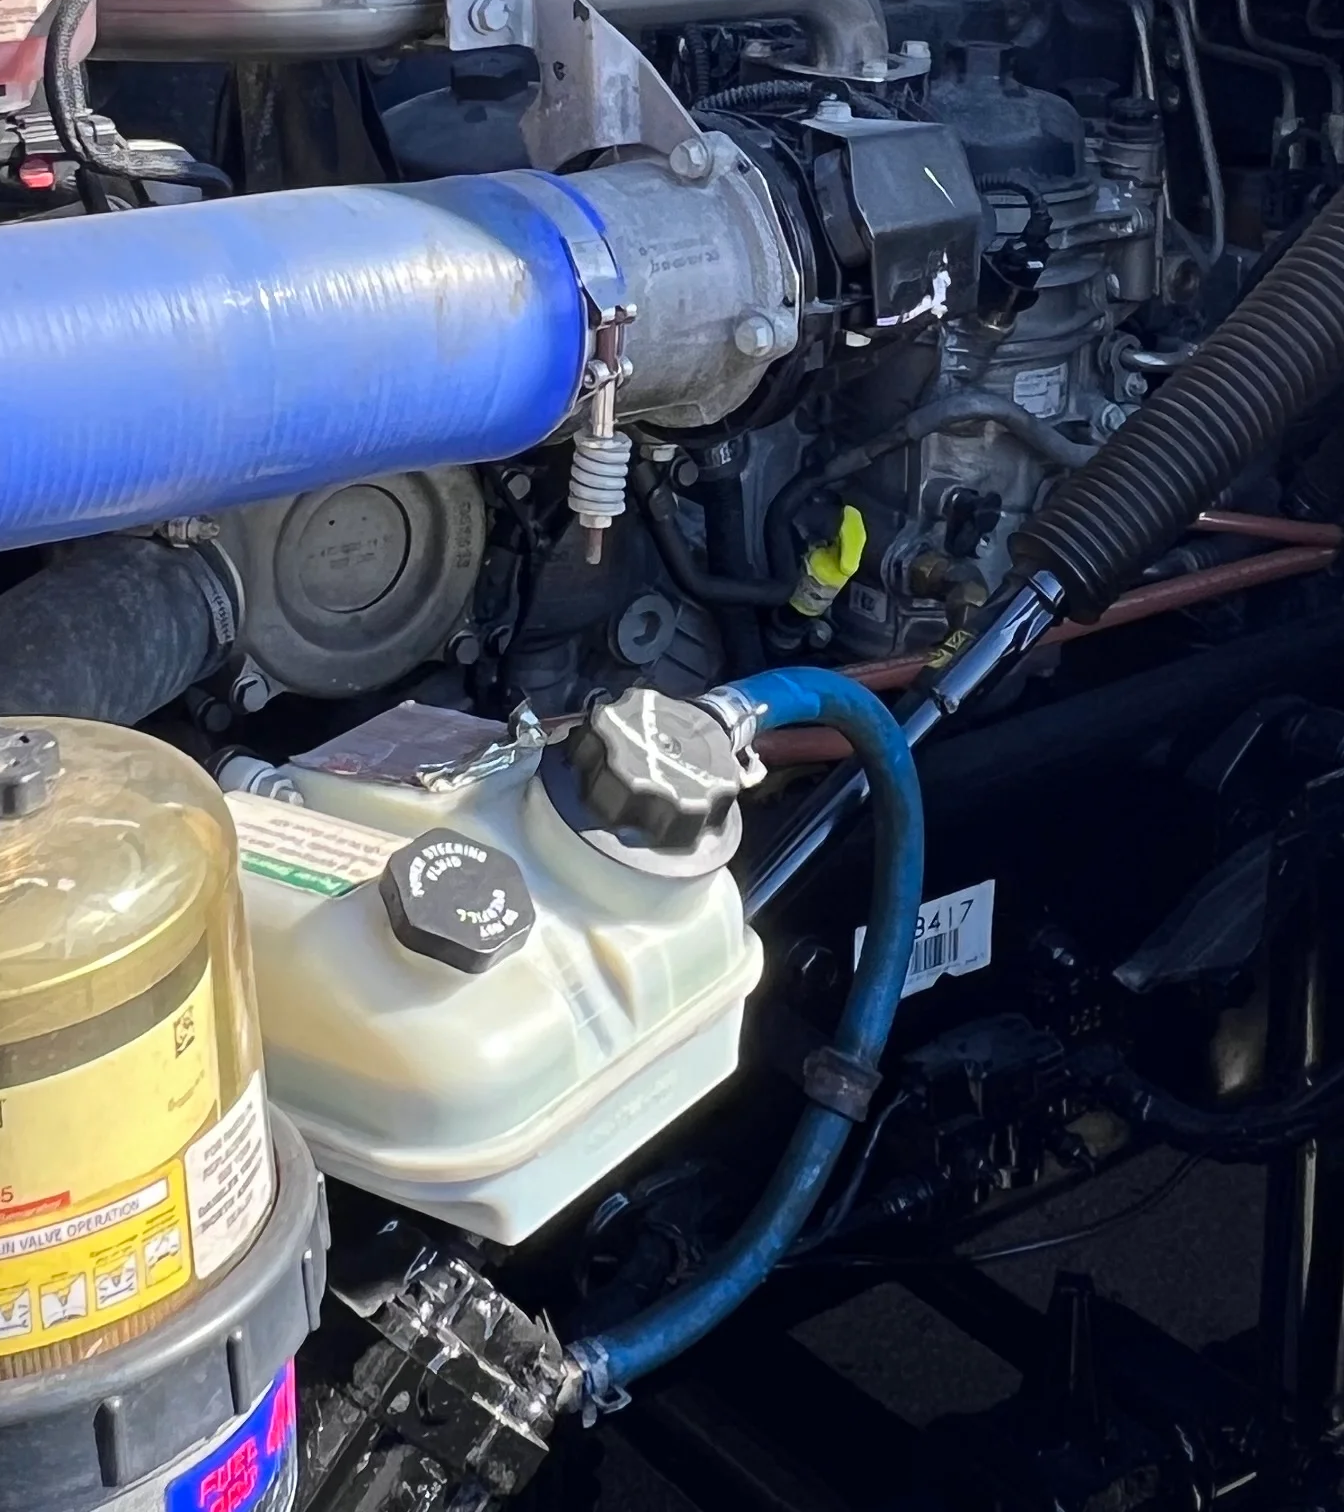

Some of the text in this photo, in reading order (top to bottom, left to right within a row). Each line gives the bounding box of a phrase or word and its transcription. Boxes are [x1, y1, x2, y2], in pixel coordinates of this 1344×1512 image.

[421, 842, 487, 863] STEERING
[426, 855, 462, 881] FLUID
[19, 1228, 62, 1250] VALVE
[67, 1199, 139, 1236] OPERATION
